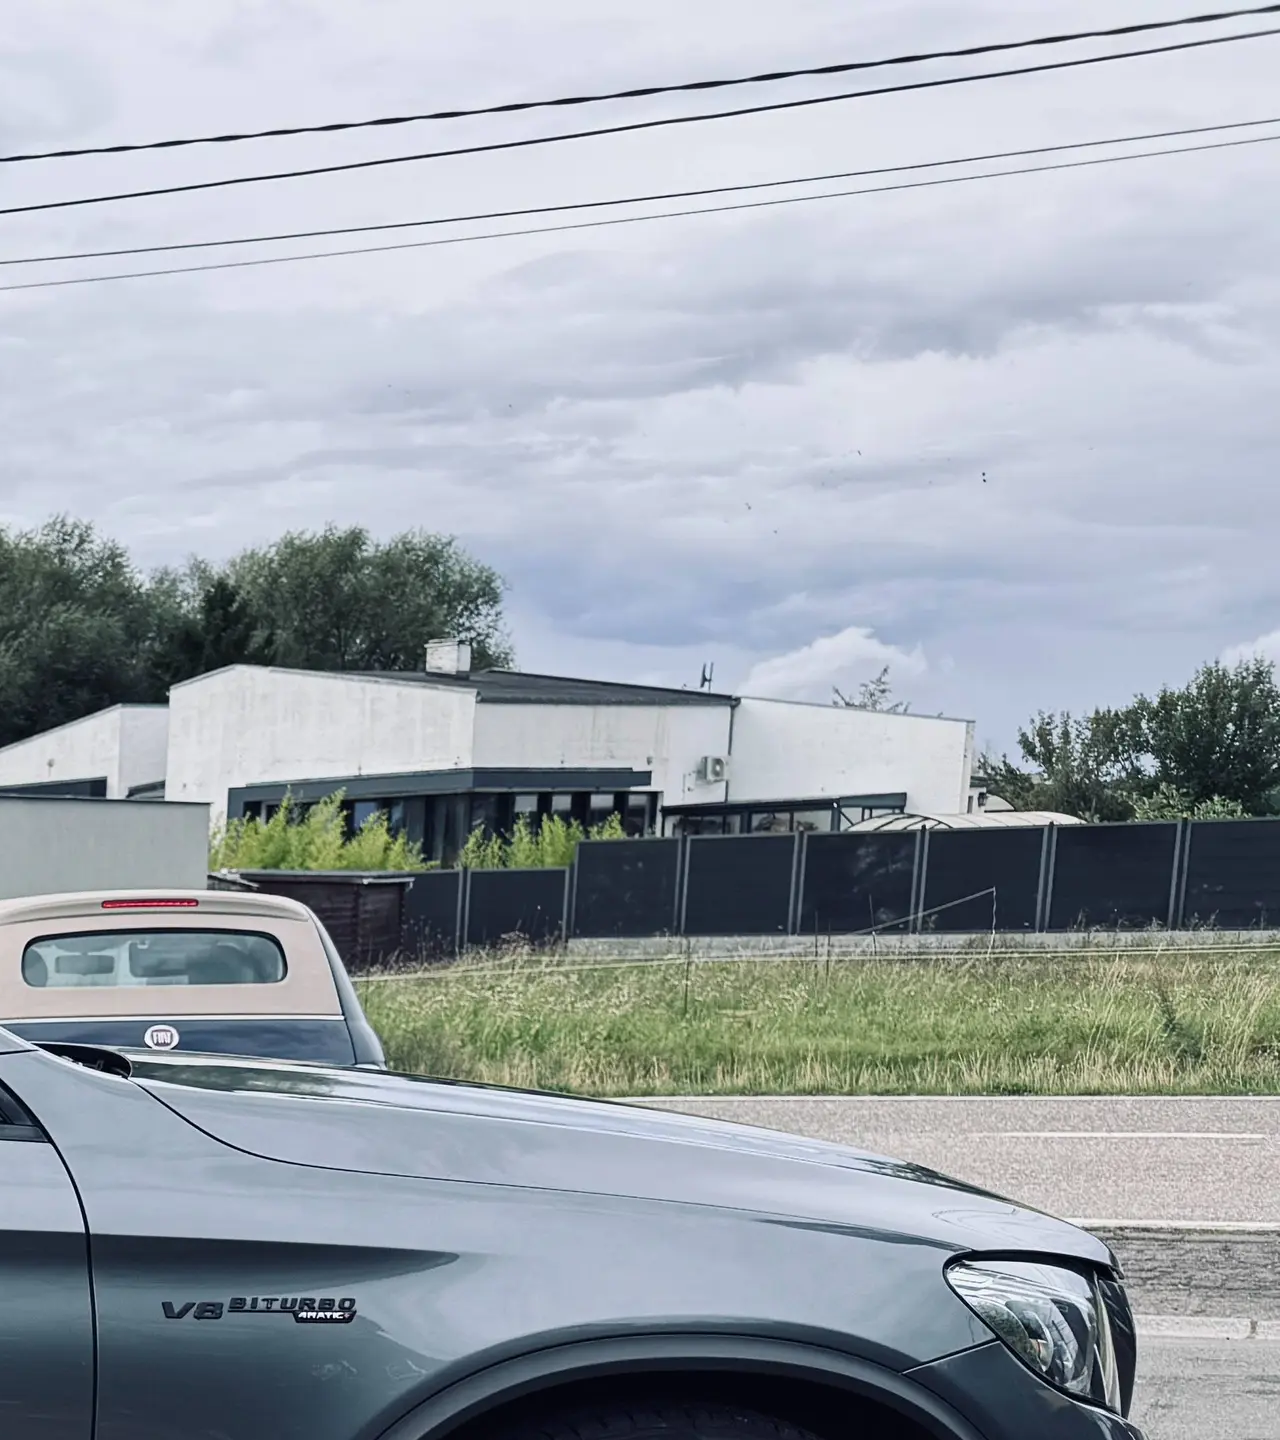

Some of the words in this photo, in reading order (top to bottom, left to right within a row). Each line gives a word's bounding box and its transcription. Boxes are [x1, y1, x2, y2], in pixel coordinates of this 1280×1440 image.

[152, 1031, 172, 1044] FIAT
[161, 1301, 224, 1320] V8
[227, 1297, 357, 1311] BITURBO
[298, 1311, 350, 1320] 4MATIC+
